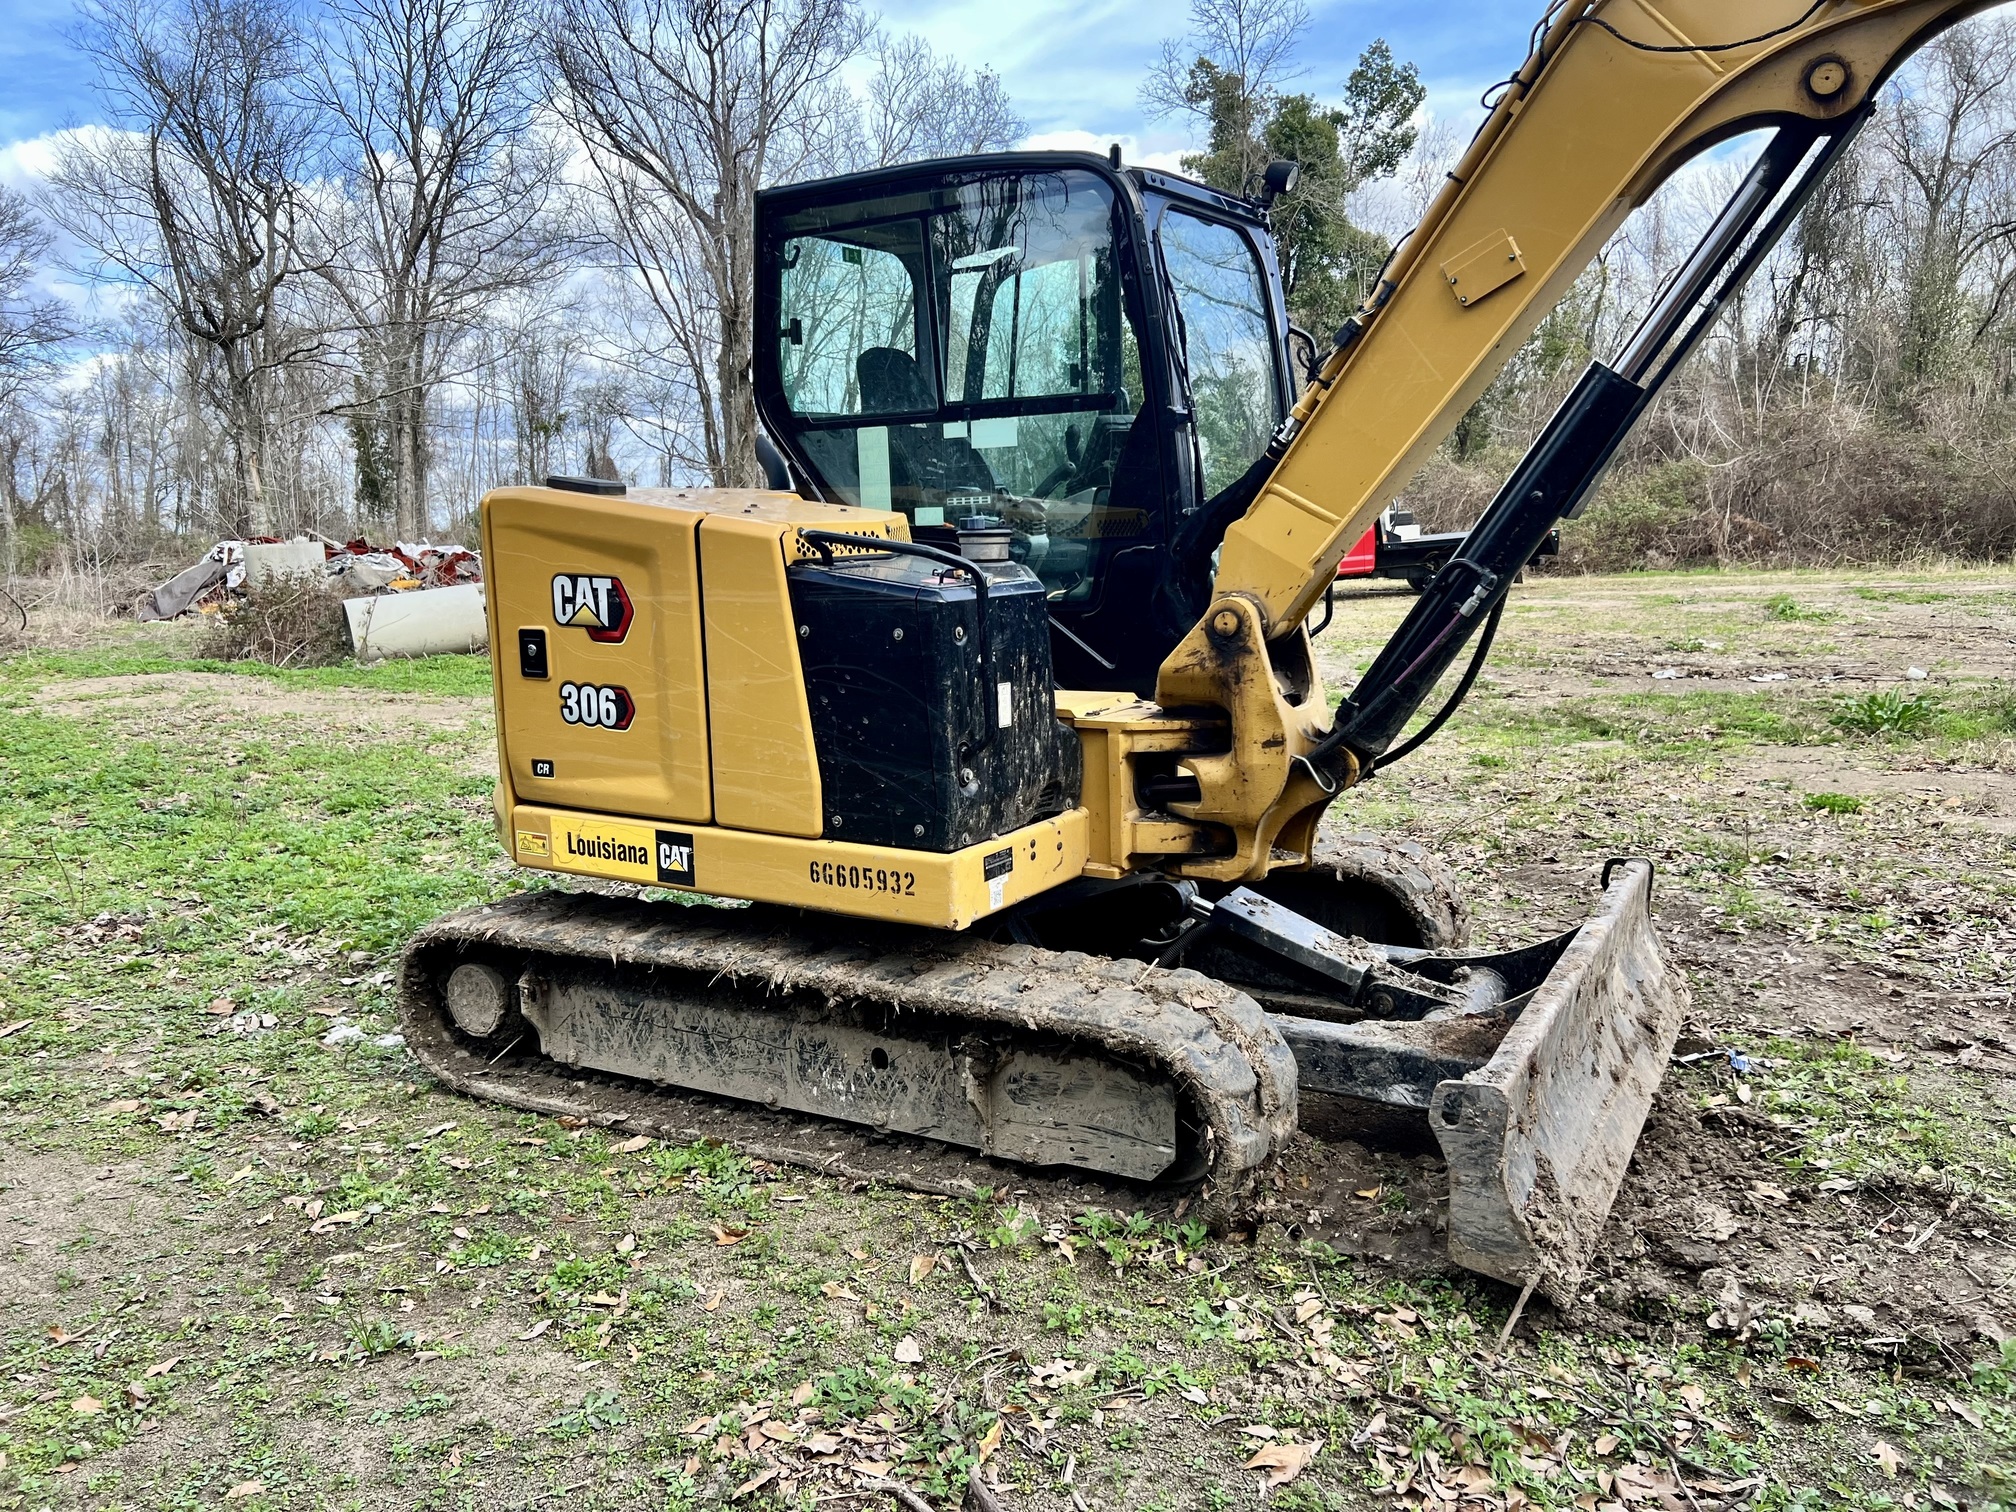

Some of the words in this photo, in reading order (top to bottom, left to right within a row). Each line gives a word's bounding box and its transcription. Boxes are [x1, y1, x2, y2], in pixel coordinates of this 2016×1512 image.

[553, 575, 612, 626] CAT
[561, 684, 617, 726] 306
[537, 763, 550, 775] CR
[567, 831, 648, 865] Louisiana
[659, 843, 690, 872] CAT
[810, 861, 915, 896] 6G605932
